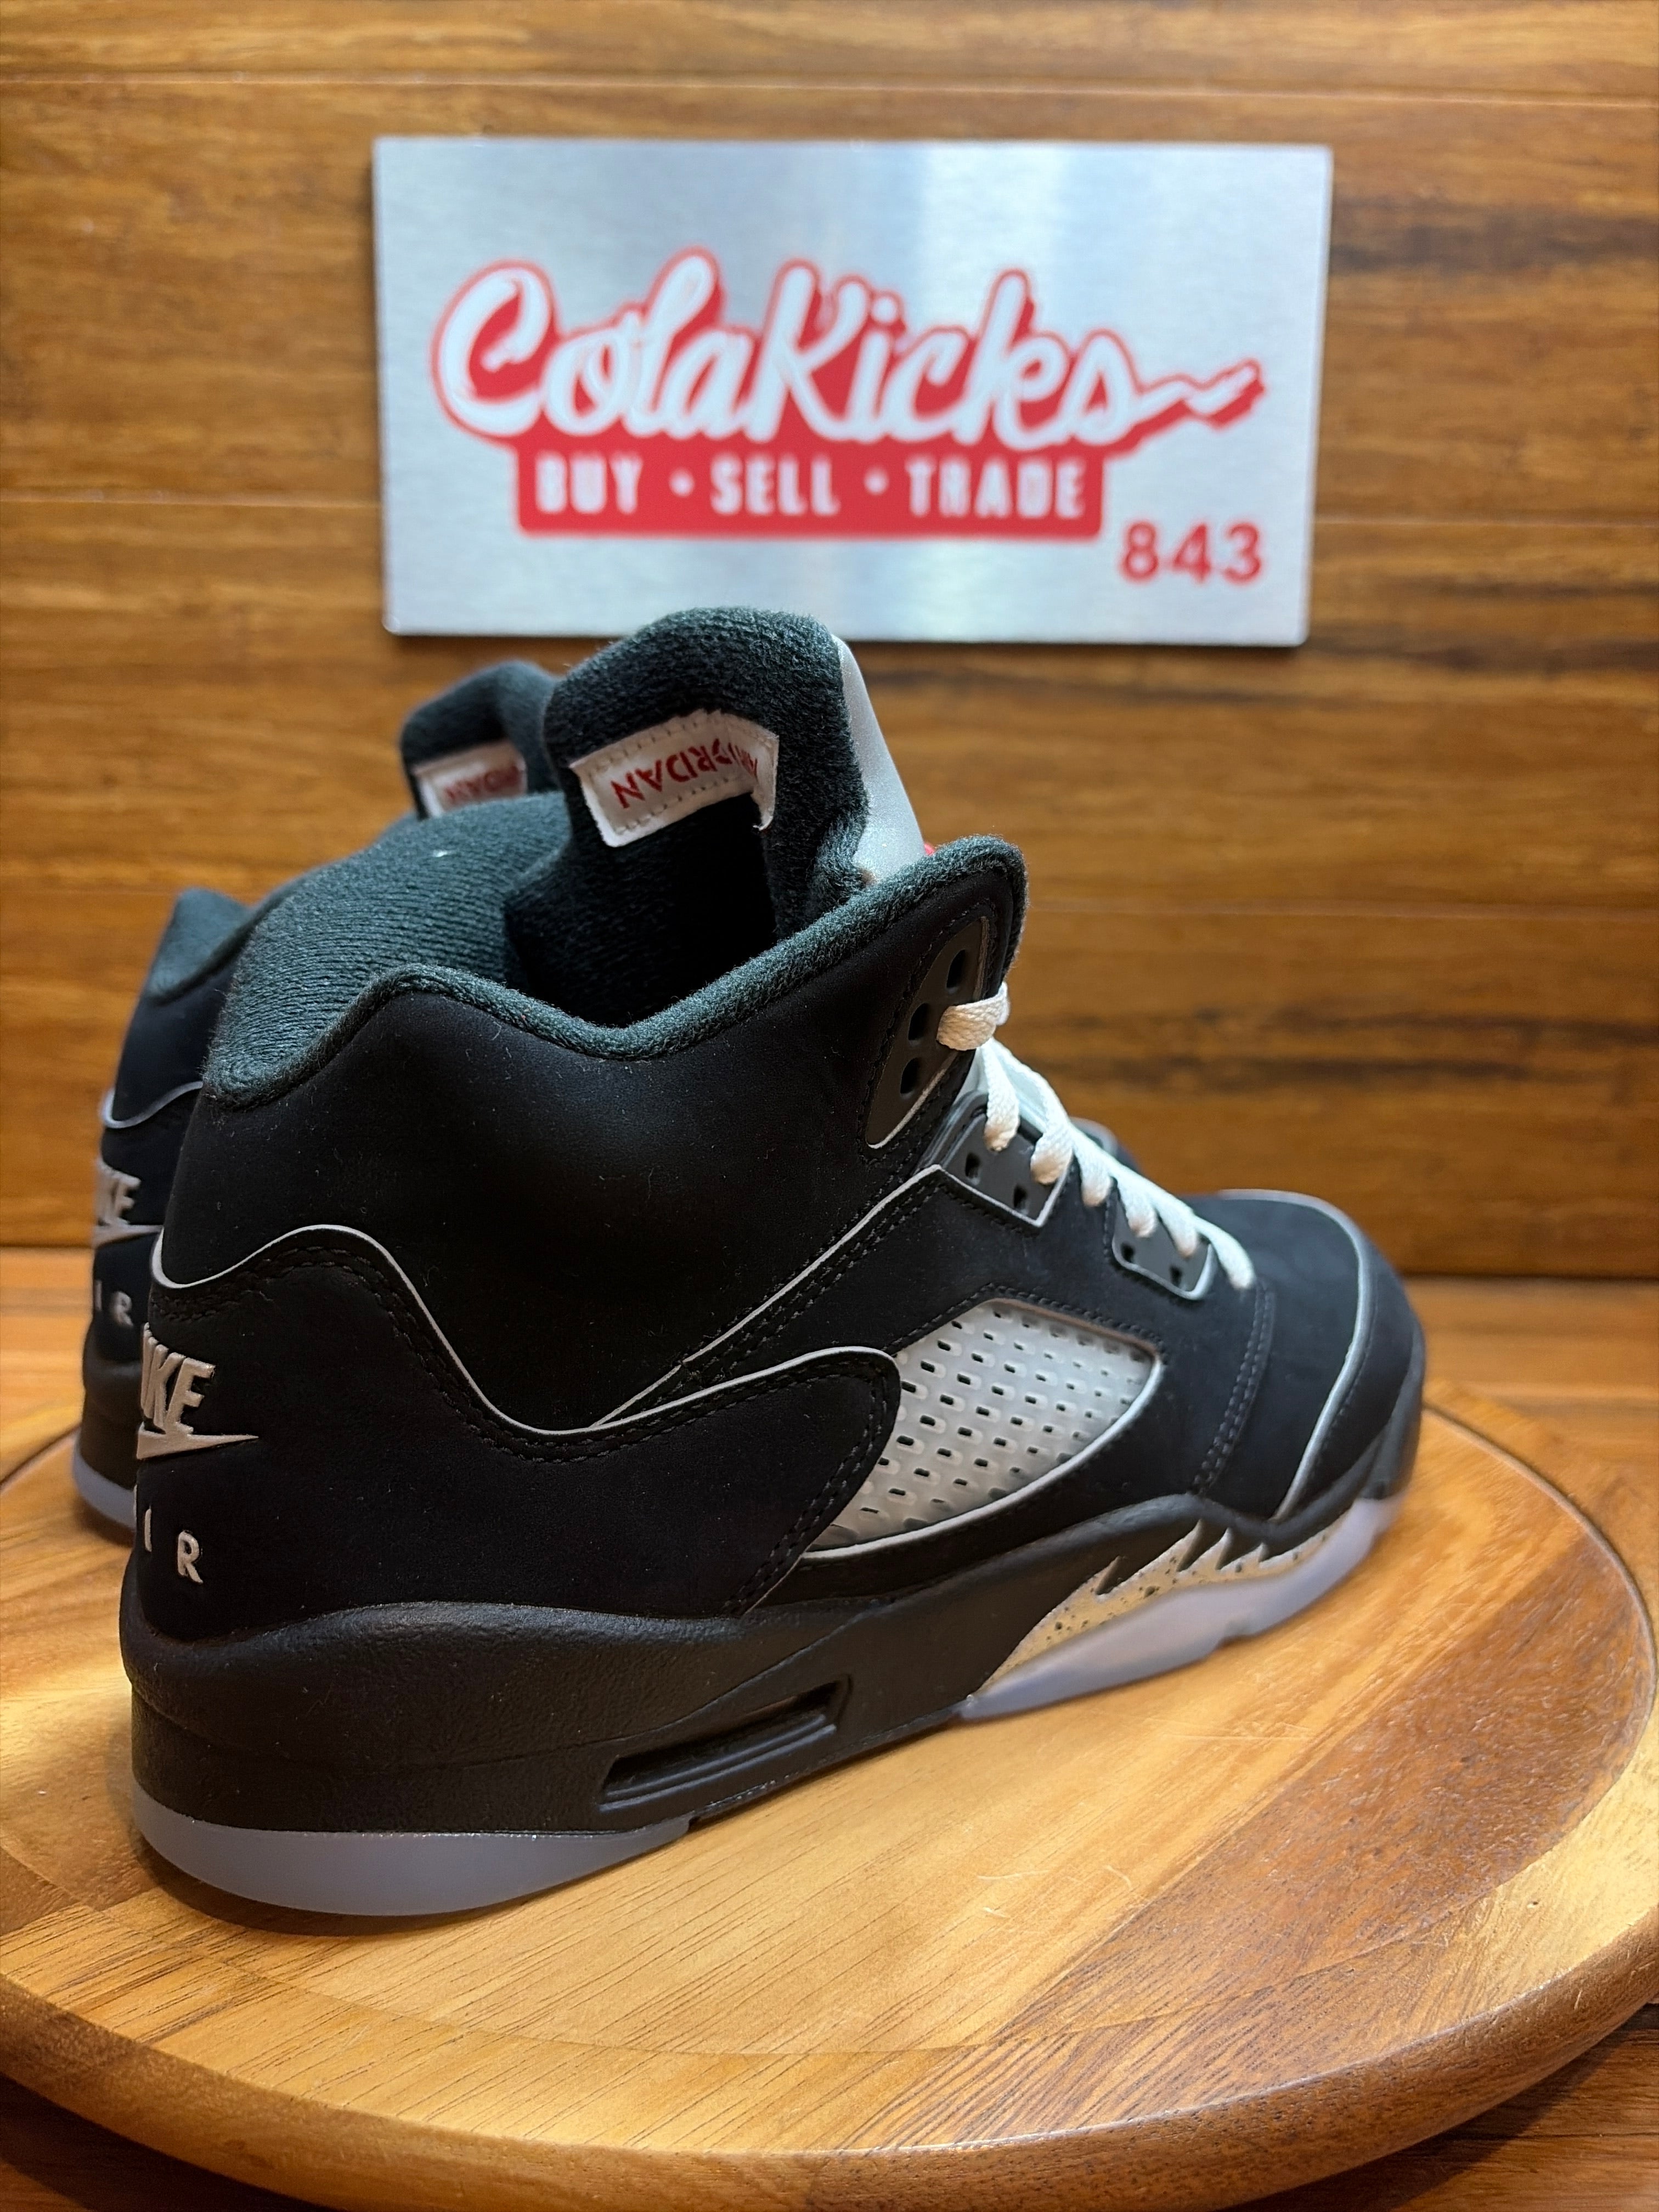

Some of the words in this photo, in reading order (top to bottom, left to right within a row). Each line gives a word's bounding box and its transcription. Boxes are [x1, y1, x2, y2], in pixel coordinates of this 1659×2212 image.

[435, 249, 1262, 451] ColaKicks
[535, 453, 643, 515] BUY
[711, 454, 840, 516] SELL
[905, 455, 1085, 518] TRADE
[1122, 521, 1263, 583] 843
